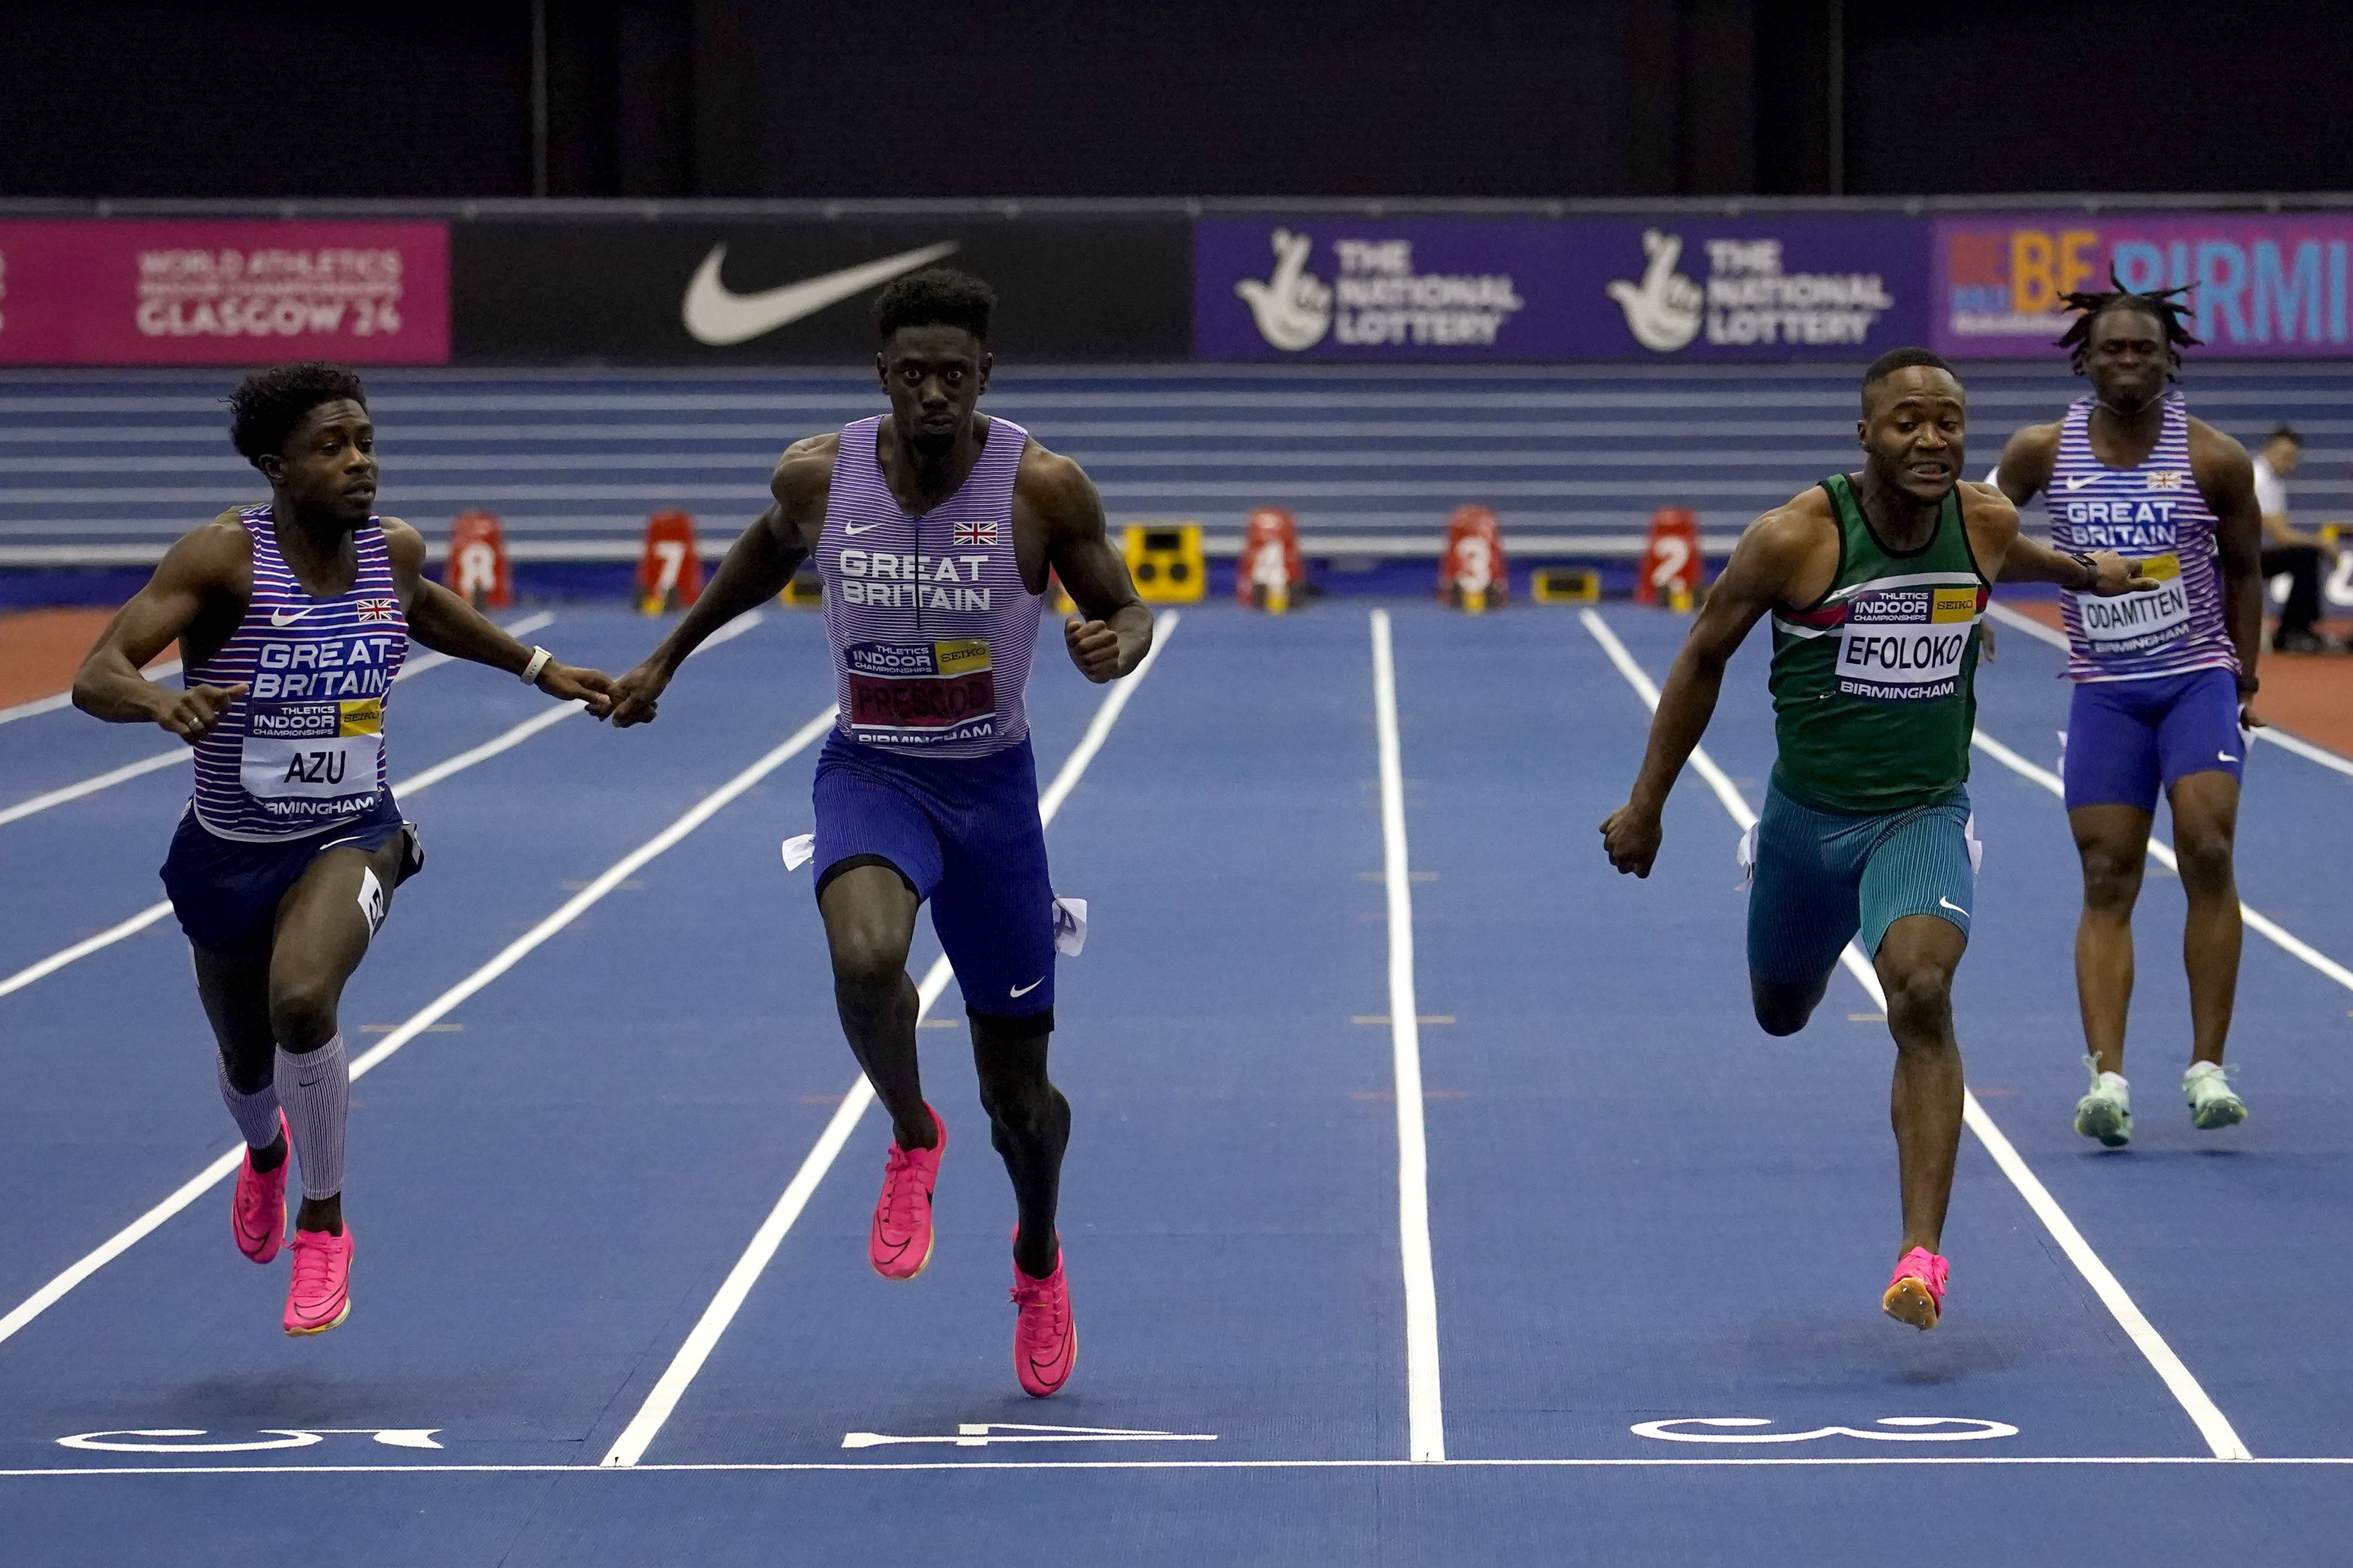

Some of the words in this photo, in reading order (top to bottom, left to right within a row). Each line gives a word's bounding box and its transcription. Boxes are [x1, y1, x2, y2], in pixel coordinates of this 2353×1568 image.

[138, 249, 243, 277] WORLD
[1334, 239, 1412, 272] THE
[1704, 239, 1782, 272] THE
[1337, 275, 1523, 309] NATIONAL
[1707, 274, 1893, 308] NATIONAL
[136, 297, 346, 335] GLASGOW
[1337, 311, 1505, 344] LOTTERY
[1707, 311, 1876, 344] LOTTERY
[2068, 502, 2176, 523] GREAT
[2072, 524, 2176, 545] BRITAIN
[653, 541, 685, 593] 7
[840, 550, 988, 581] GREAT
[1457, 537, 1492, 592] 3
[1650, 536, 1690, 592] 2
[841, 579, 990, 610] BRITAIN
[1855, 602, 1928, 613] INDOOR
[1937, 600, 1973, 610] SEIKO
[2087, 586, 2183, 628] ODAMTTEN
[260, 639, 392, 669] GREAT
[852, 650, 931, 667] INDOOR
[941, 647, 986, 663] SEIKO
[1845, 634, 1962, 669] EFOLOKO
[854, 662, 933, 673] CHAMPIONSHIPS
[252, 669, 388, 698] BRITAIN
[1840, 681, 1954, 699] BIRMINGHAM
[254, 715, 335, 729] INDOOR
[343, 711, 379, 723] SEIKO
[283, 750, 346, 784] AZU
[54, 1429, 444, 1452] 5
[841, 1423, 1218, 1448] 4
[1631, 1416, 2019, 1443] 3
